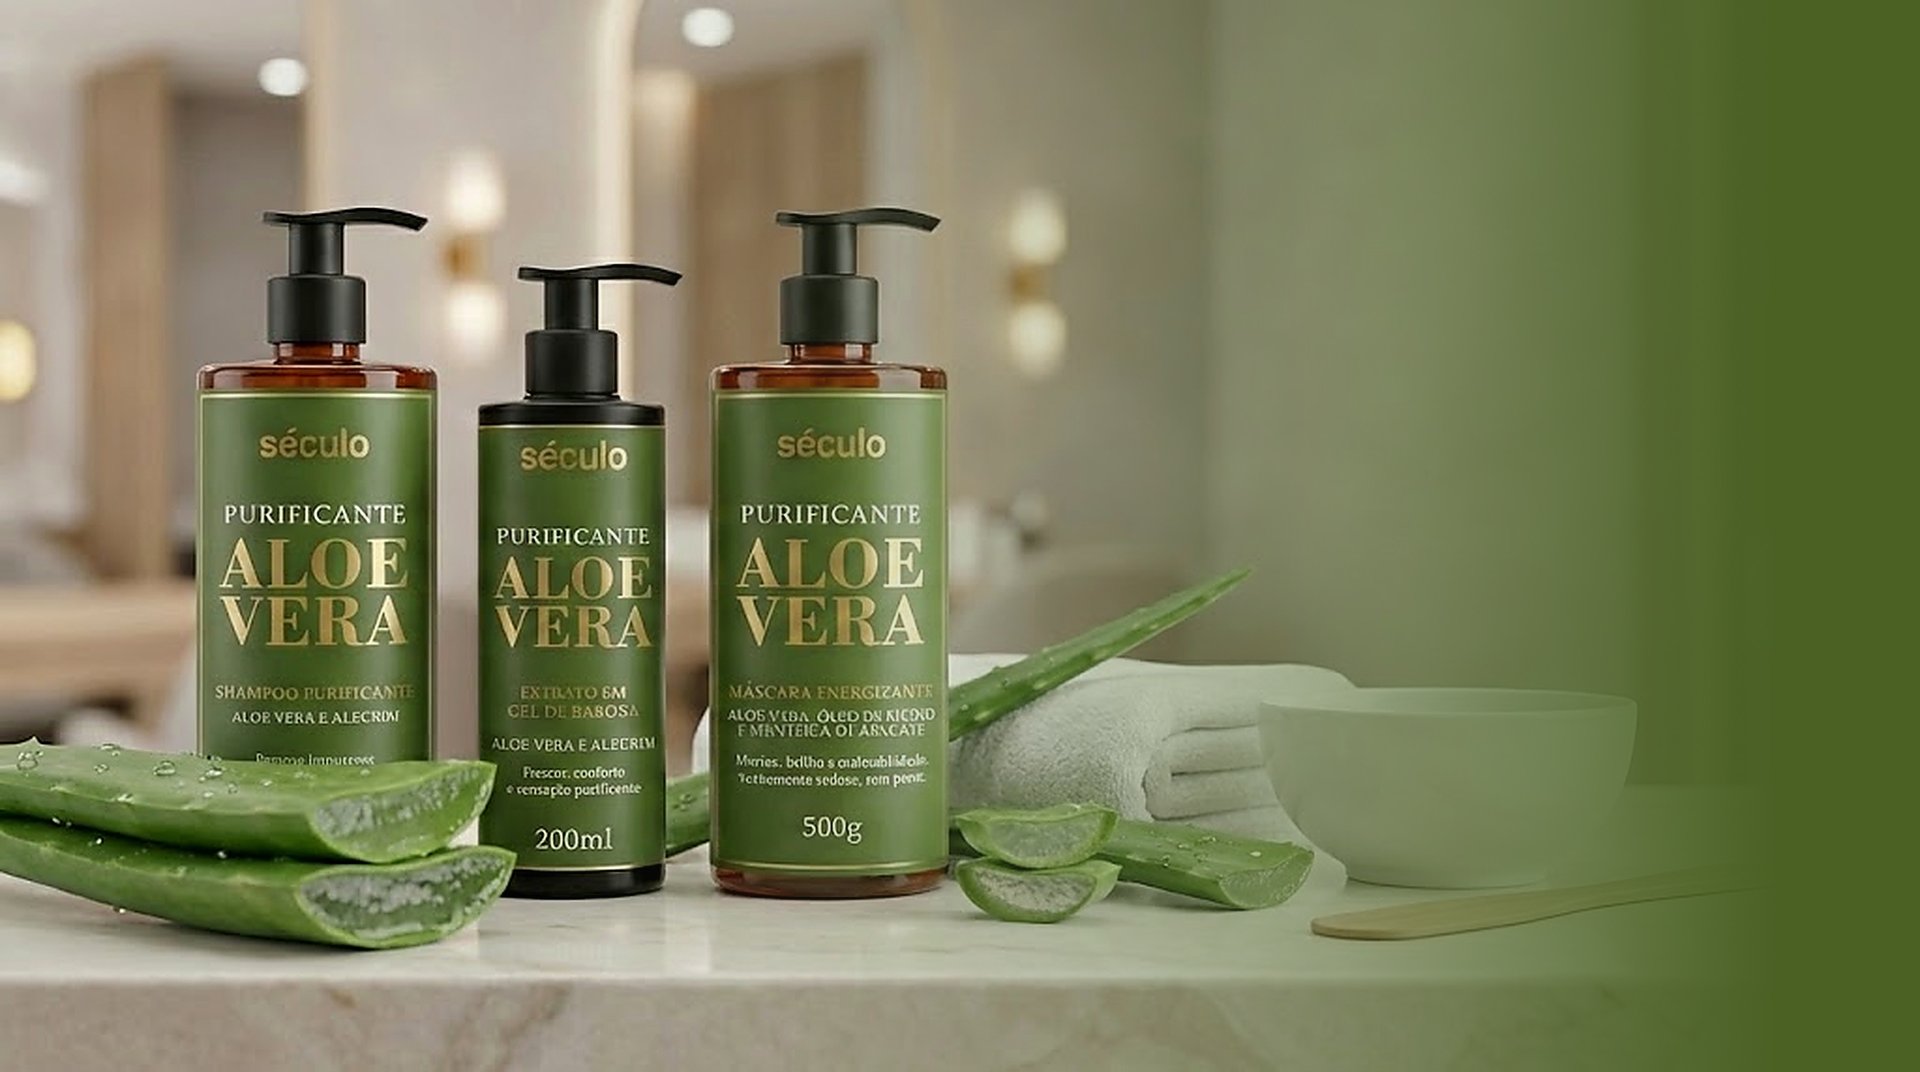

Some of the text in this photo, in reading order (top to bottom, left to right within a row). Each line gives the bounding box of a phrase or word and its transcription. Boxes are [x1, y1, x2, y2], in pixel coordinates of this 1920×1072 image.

[259, 427, 371, 459] século
[521, 440, 628, 471] século
[777, 427, 886, 458] século
[224, 503, 406, 525] PURIFICANTE
[741, 503, 921, 525] PURIFICANTE
[497, 527, 650, 546] PURIFICANTE
[219, 537, 408, 590] ALOE
[494, 555, 652, 600] ALOE
[736, 537, 923, 590] ALOE
[219, 594, 408, 646] VERA
[495, 604, 653, 649] VERA
[736, 594, 925, 647] VERA
[215, 685, 299, 700] SHAMPOO
[274, 711, 315, 725] VERA
[319, 711, 328, 724] E
[535, 827, 613, 850] 200ml
[802, 816, 864, 844] 500g
